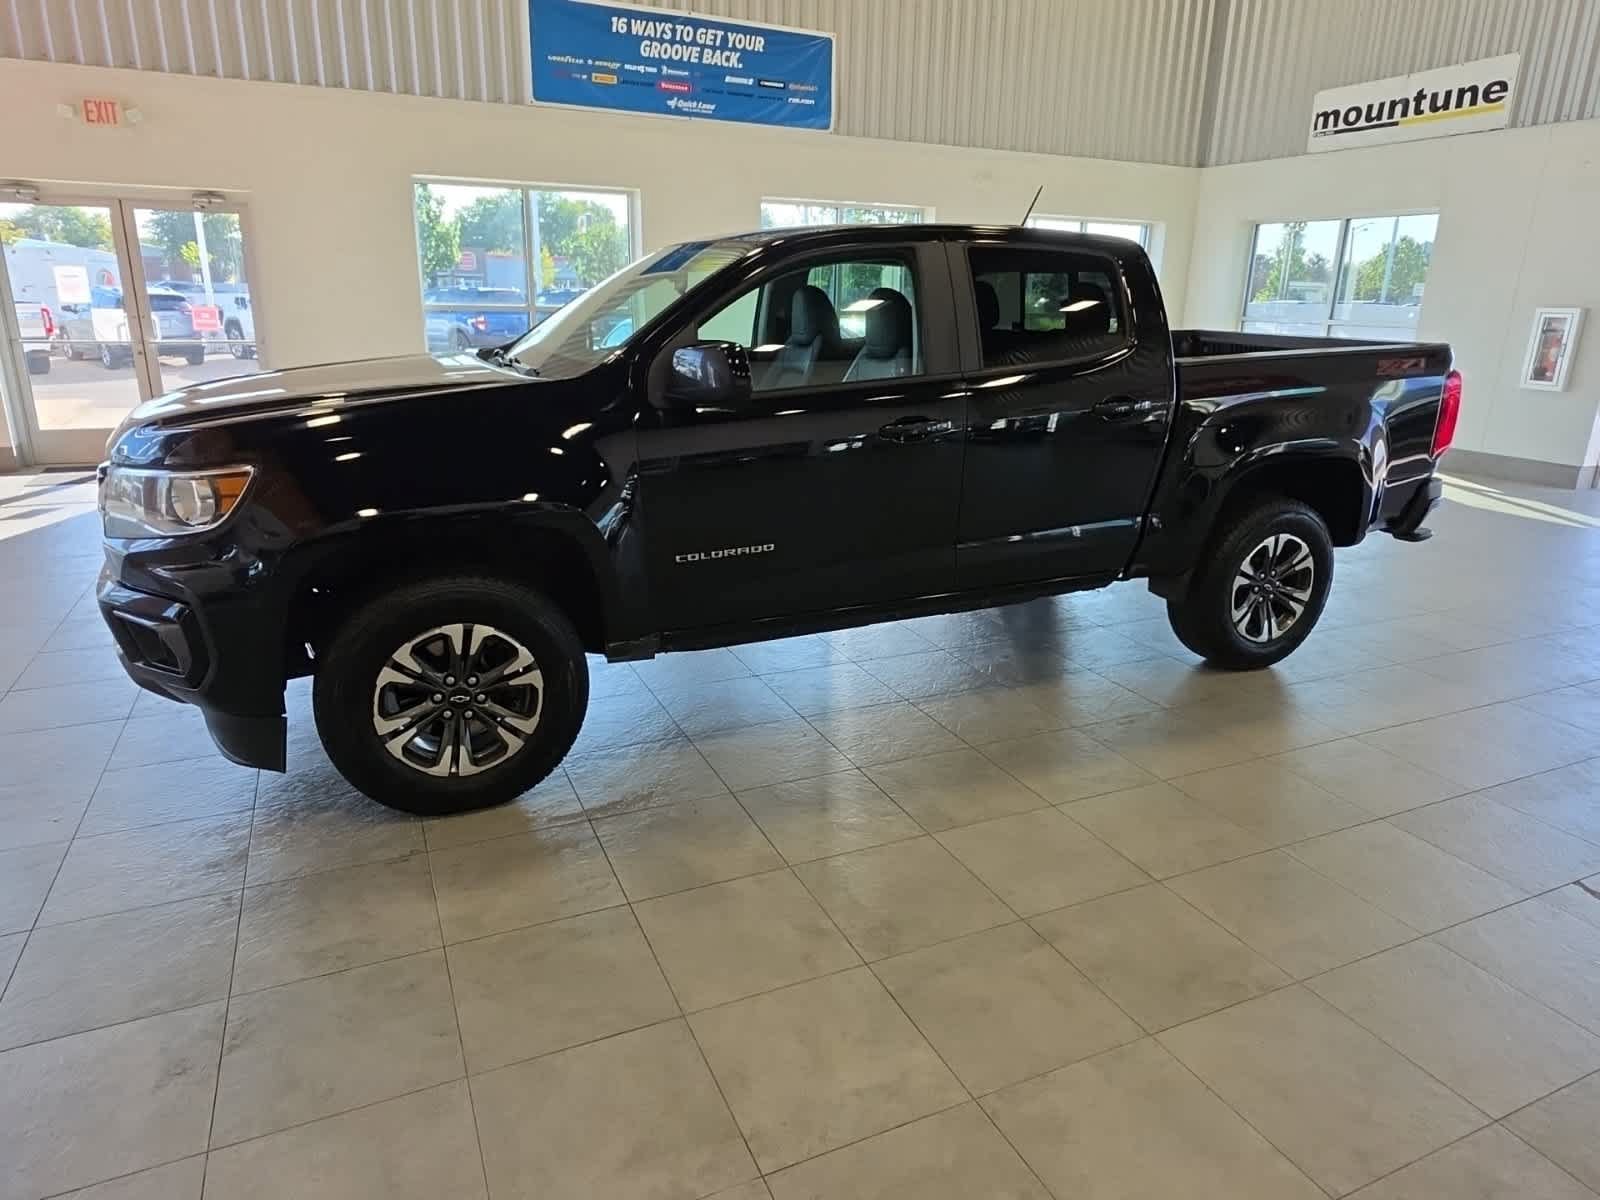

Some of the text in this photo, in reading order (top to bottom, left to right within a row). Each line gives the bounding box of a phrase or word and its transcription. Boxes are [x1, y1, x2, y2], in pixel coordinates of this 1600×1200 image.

[611, 17, 765, 52] 16 WAYS TO GET YOUR
[640, 40, 743, 68] GROOVE BACK.
[83, 100, 117, 125] EXIT
[1313, 80, 1509, 132] mountune
[675, 543, 775, 563] COLORADO
